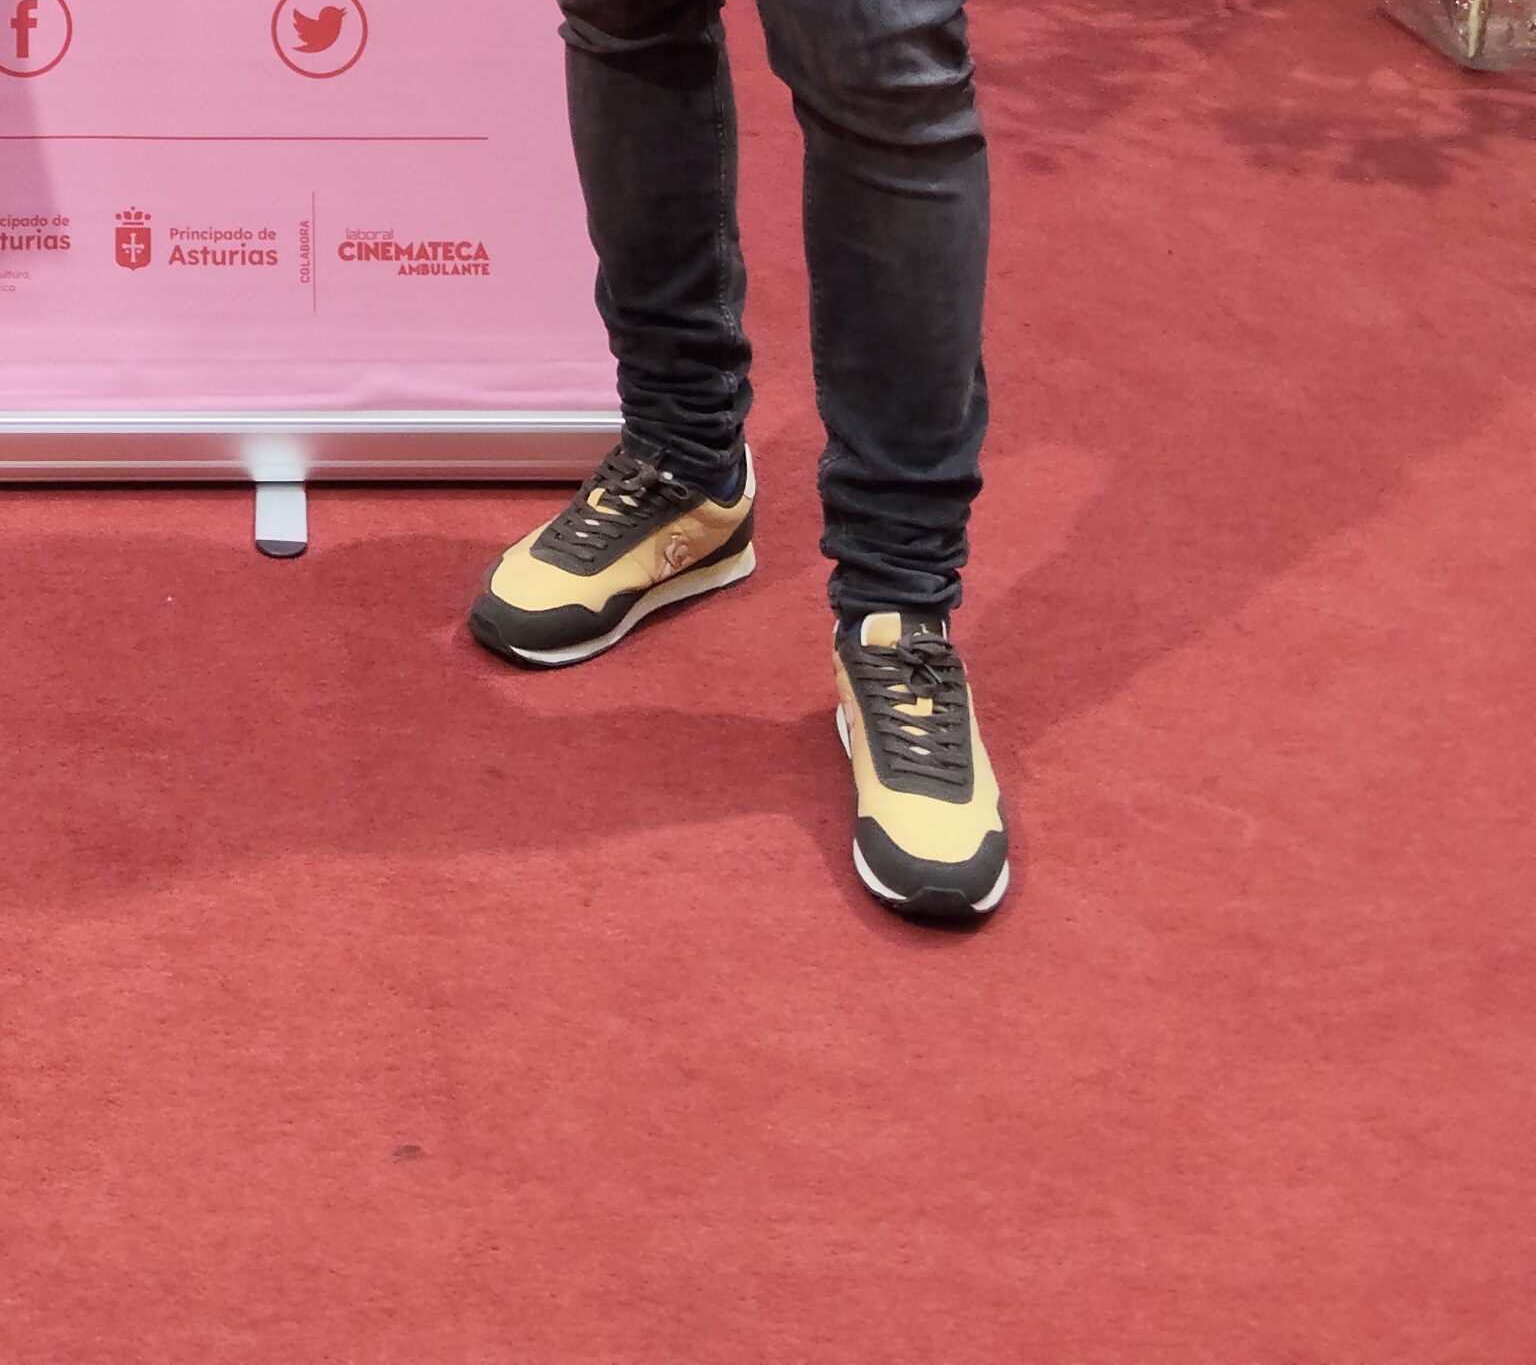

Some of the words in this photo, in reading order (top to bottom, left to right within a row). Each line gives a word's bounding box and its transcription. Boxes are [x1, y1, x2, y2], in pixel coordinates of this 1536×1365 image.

[51, 214, 70, 228] de
[169, 226, 253, 244] Principado
[257, 226, 277, 241] de
[168, 242, 279, 266] Asturias
[299, 220, 310, 284] COLABORA
[337, 241, 490, 262] CINEMATECA
[398, 263, 490, 276] AMBULANTE
